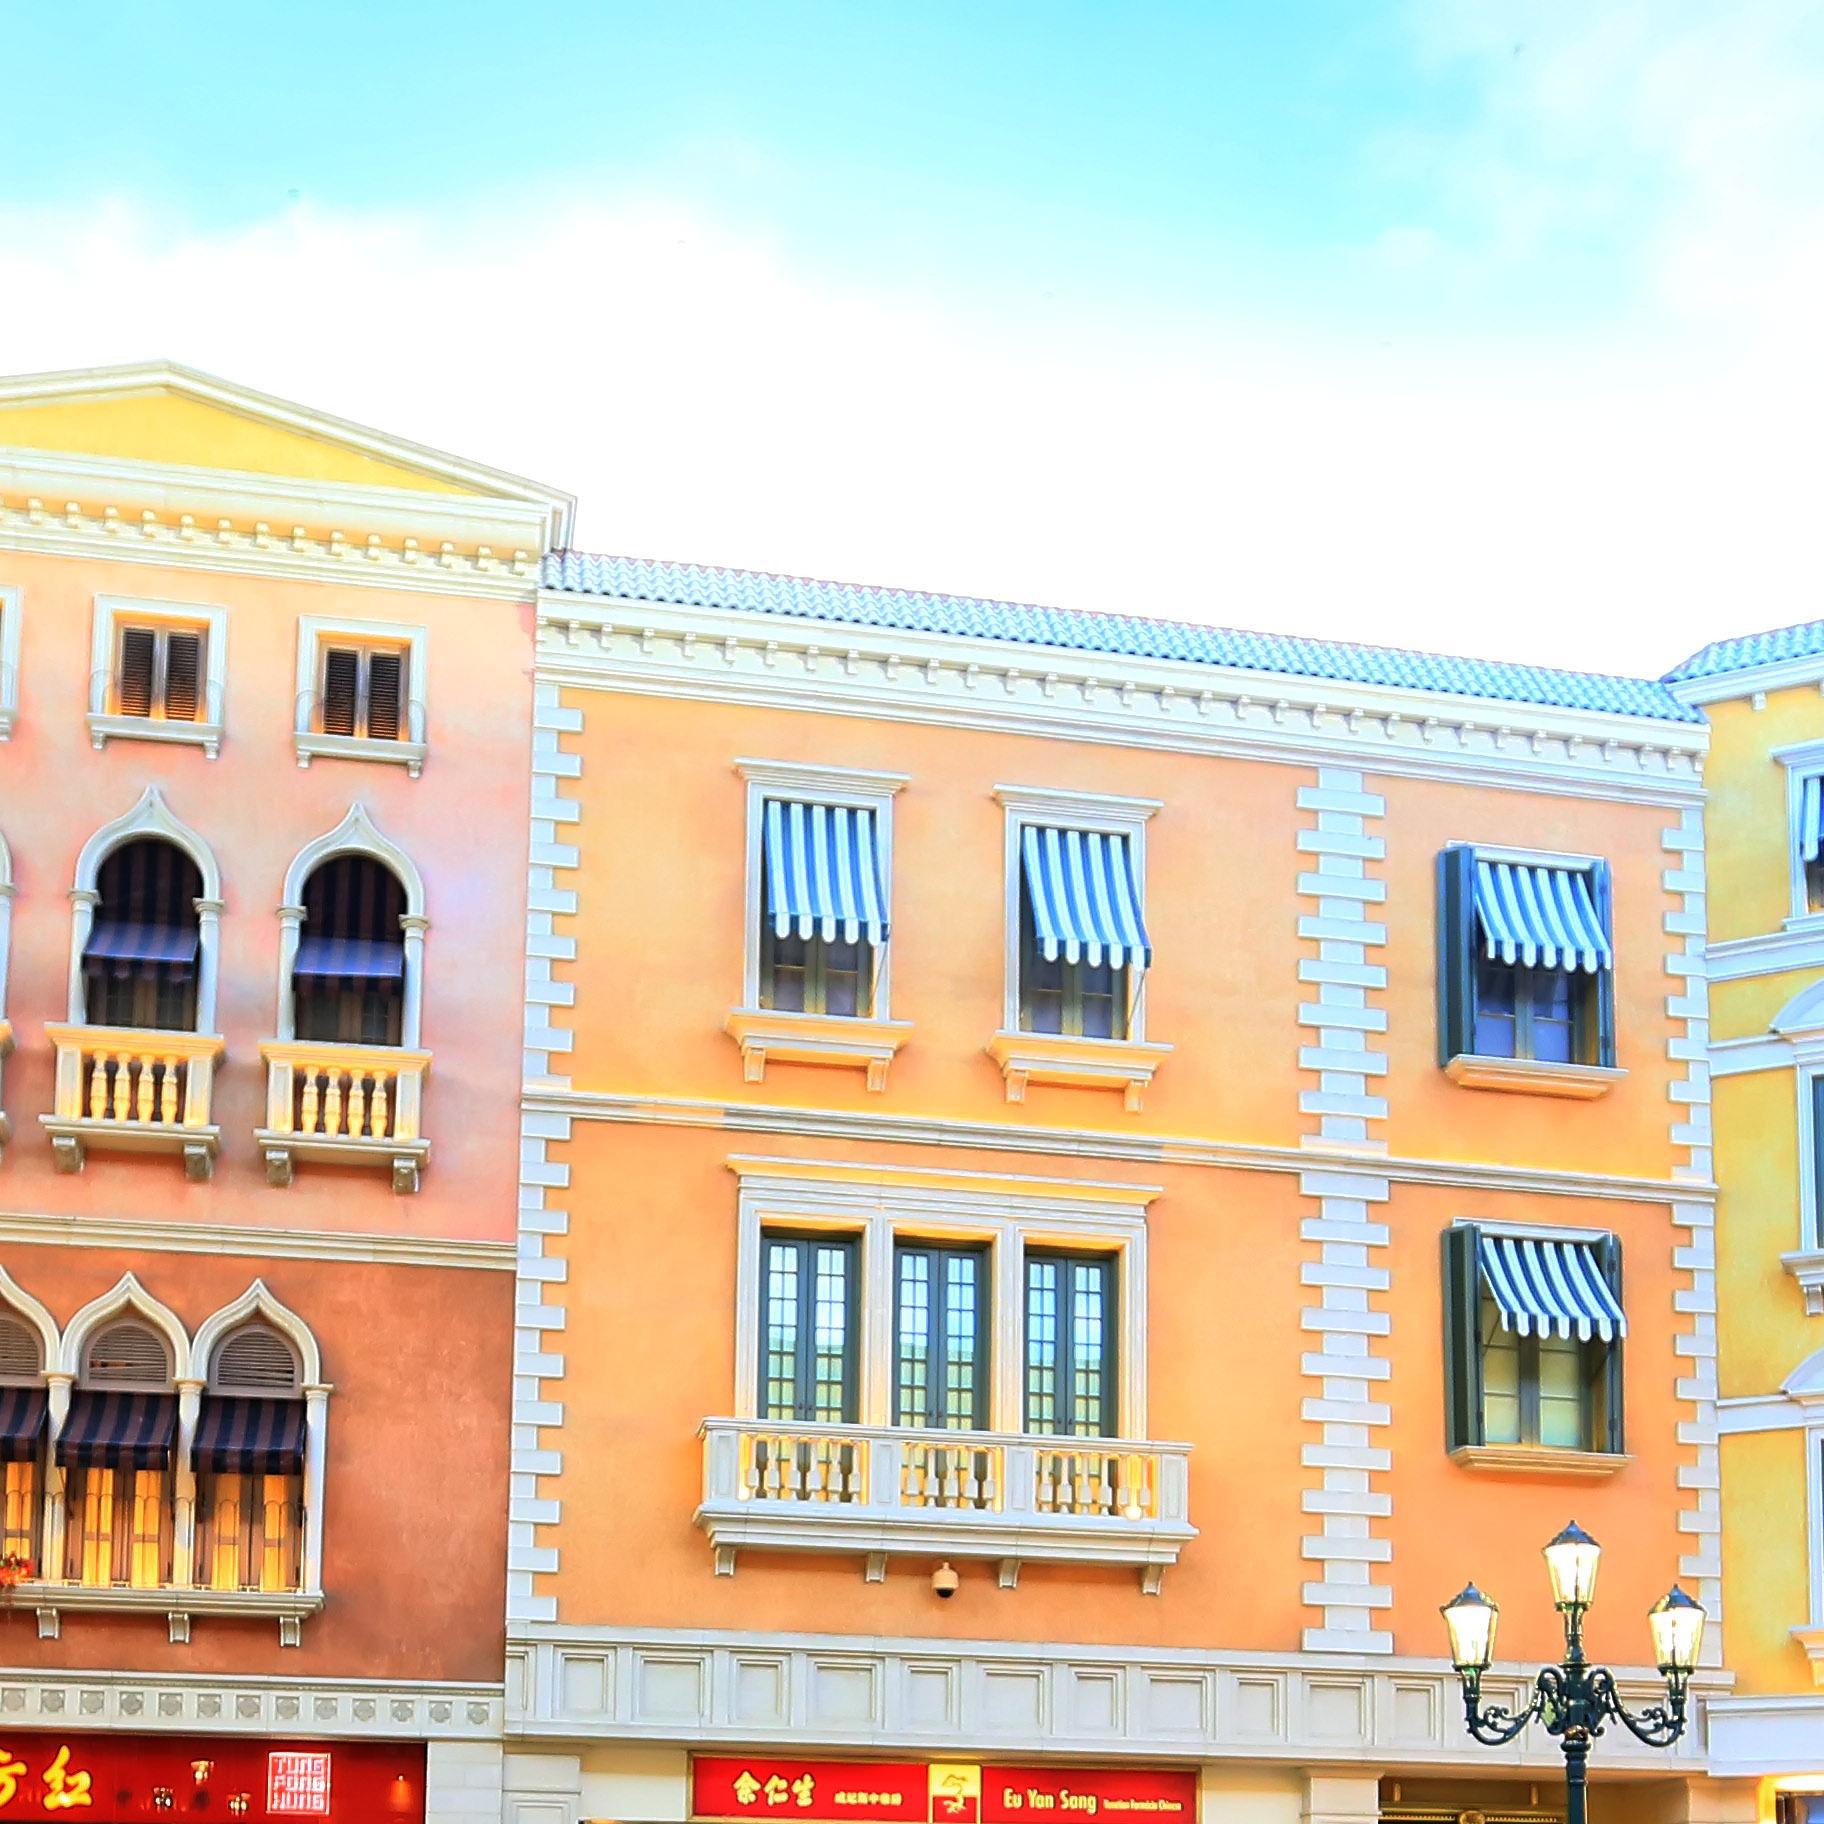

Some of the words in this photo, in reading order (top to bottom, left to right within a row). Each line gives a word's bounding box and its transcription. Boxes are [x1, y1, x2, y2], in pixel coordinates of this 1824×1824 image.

[733, 1771, 815, 1806] 余仁生
[1003, 1787, 1023, 1809] Eu
[1027, 1788, 1055, 1810] Yan
[1059, 1788, 1098, 1815] Sang
